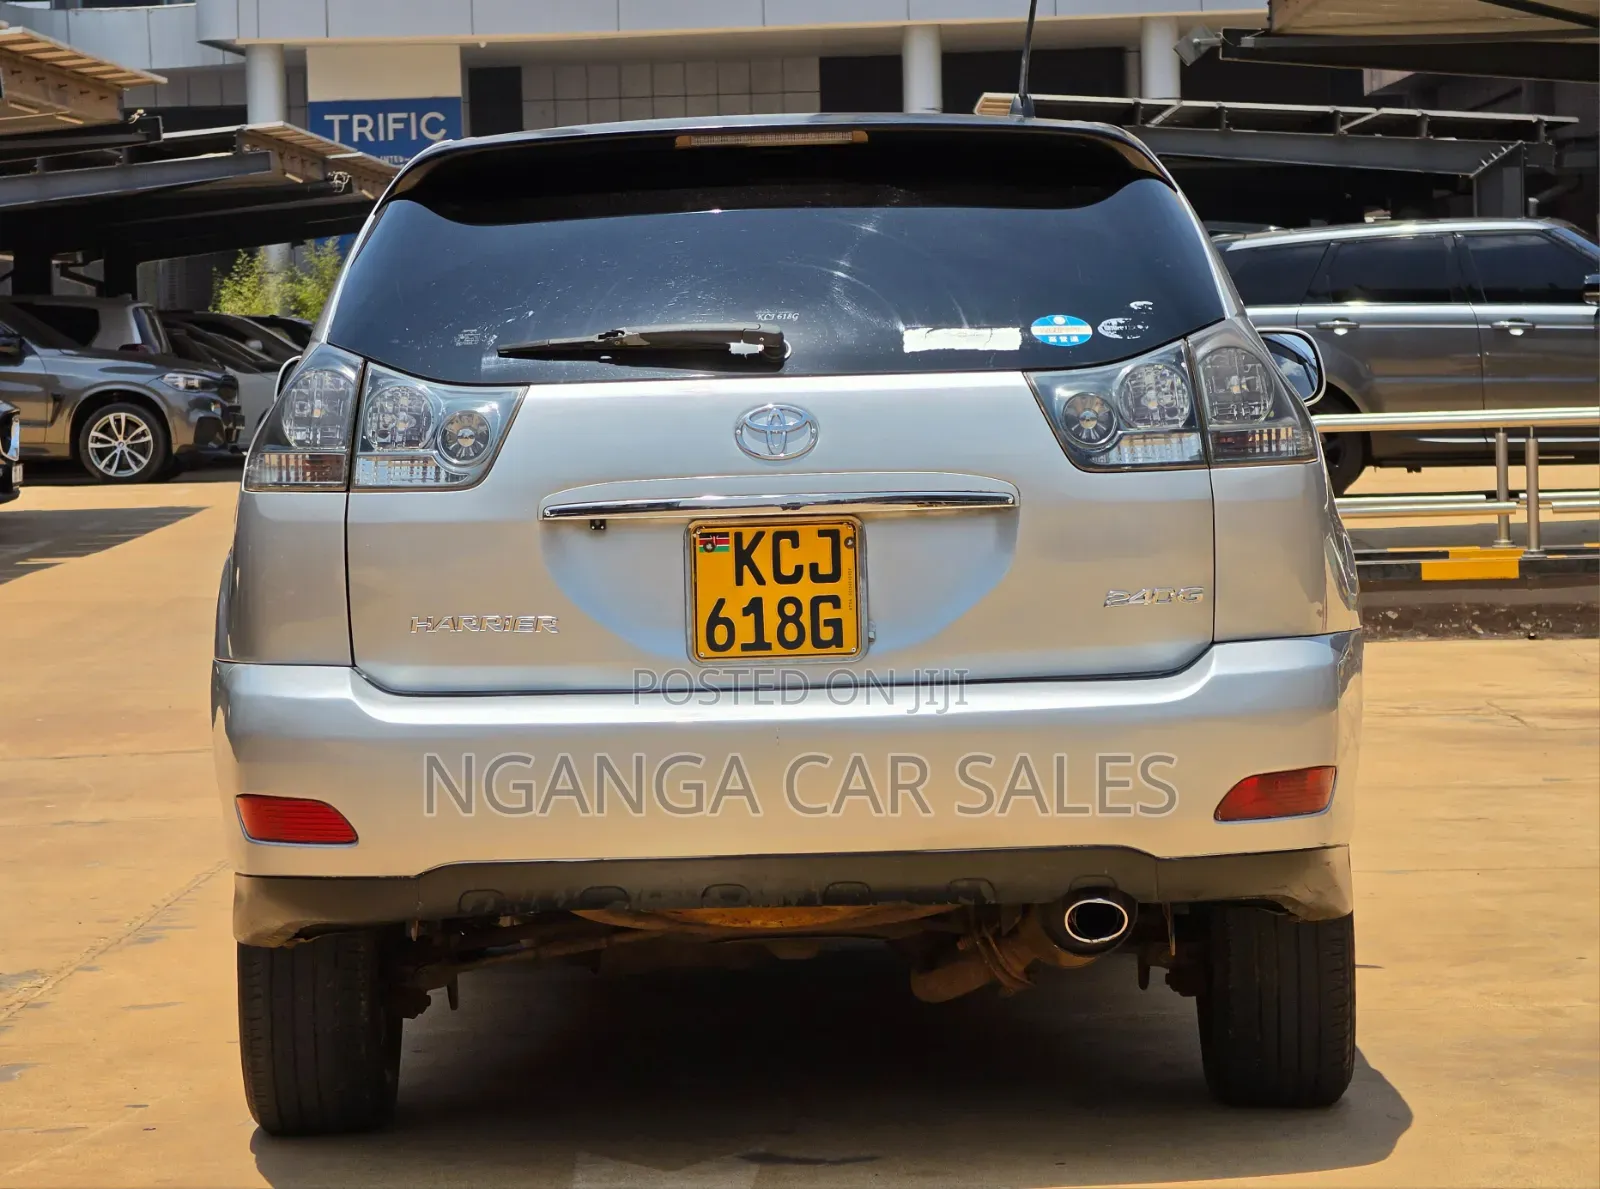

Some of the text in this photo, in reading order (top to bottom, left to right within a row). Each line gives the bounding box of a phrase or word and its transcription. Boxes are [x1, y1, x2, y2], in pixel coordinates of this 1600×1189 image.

[324, 111, 447, 143] TRIFIC
[734, 529, 842, 586] KCJ
[1103, 586, 1204, 608] 240G
[410, 615, 560, 634] HARRIER
[706, 595, 844, 653] 618G
